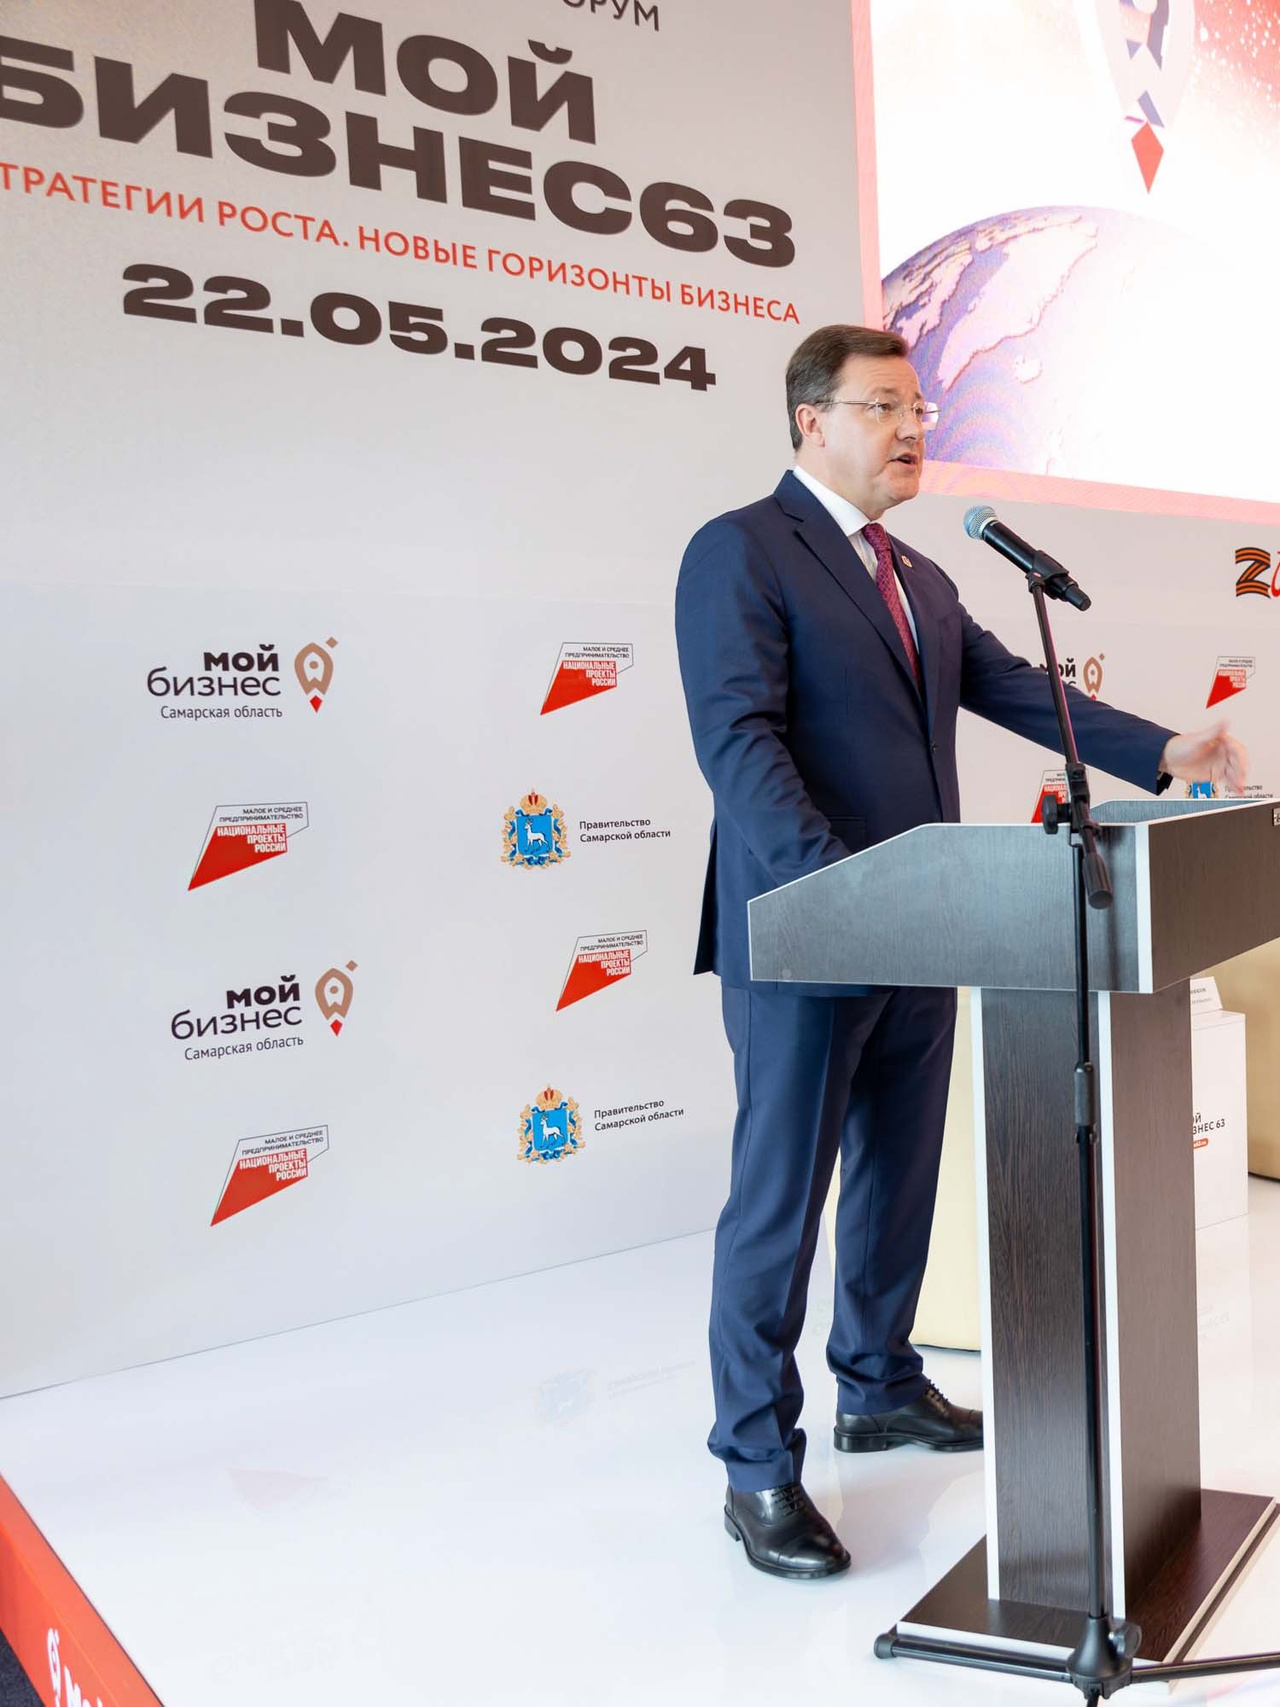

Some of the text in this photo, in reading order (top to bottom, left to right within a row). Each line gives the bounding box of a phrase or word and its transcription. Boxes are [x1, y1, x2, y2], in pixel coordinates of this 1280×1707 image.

[254, 0, 597, 145] МОЙ
[0, 35, 796, 269] БИЗНЕС63
[0, 162, 800, 324] ТРАТЕГИИ РОСТА. НОВЫЕ ГОРИЗОНТЫ БИЗНЕСА
[122, 263, 717, 392] 22.05.2024
[203, 644, 279, 672] мой
[563, 661, 615, 670] НАЦИОНАЛЬНЫЕ
[147, 666, 281, 696] бизнес
[586, 670, 616, 678] ПРОЕКТЫ
[592, 678, 616, 686] РОССИИ
[160, 705, 283, 721] Самарская область
[217, 824, 285, 837] НАЦИОНАЛЬНЫЕ
[579, 819, 651, 831] Правительство
[247, 834, 285, 844] ПРОЕКТЫ
[580, 830, 671, 843] Самарской области
[254, 843, 286, 853] РОССИИ
[578, 950, 629, 963] НАЦИОНАЛЬНЫЕ
[600, 958, 630, 969] ПРОЕКТЫ
[606, 966, 630, 976] РОССИИ
[226, 974, 300, 1009] мой
[171, 1006, 302, 1040] бизнес
[184, 1036, 304, 1060] Самарская область
[594, 1100, 664, 1119] Правительство
[594, 1108, 684, 1131] Самарской области
[1192, 1118, 1225, 1135] ЗНЕС 63
[264, 1136, 287, 1144] МАЛОЕ
[295, 1130, 323, 1139] СРЕДНЕЕ
[240, 1150, 306, 1170] НАЦИОНАЛЬНЫЕ
[268, 1159, 306, 1173] ПРОЕКТЫ
[276, 1168, 307, 1181] РОССИИ
